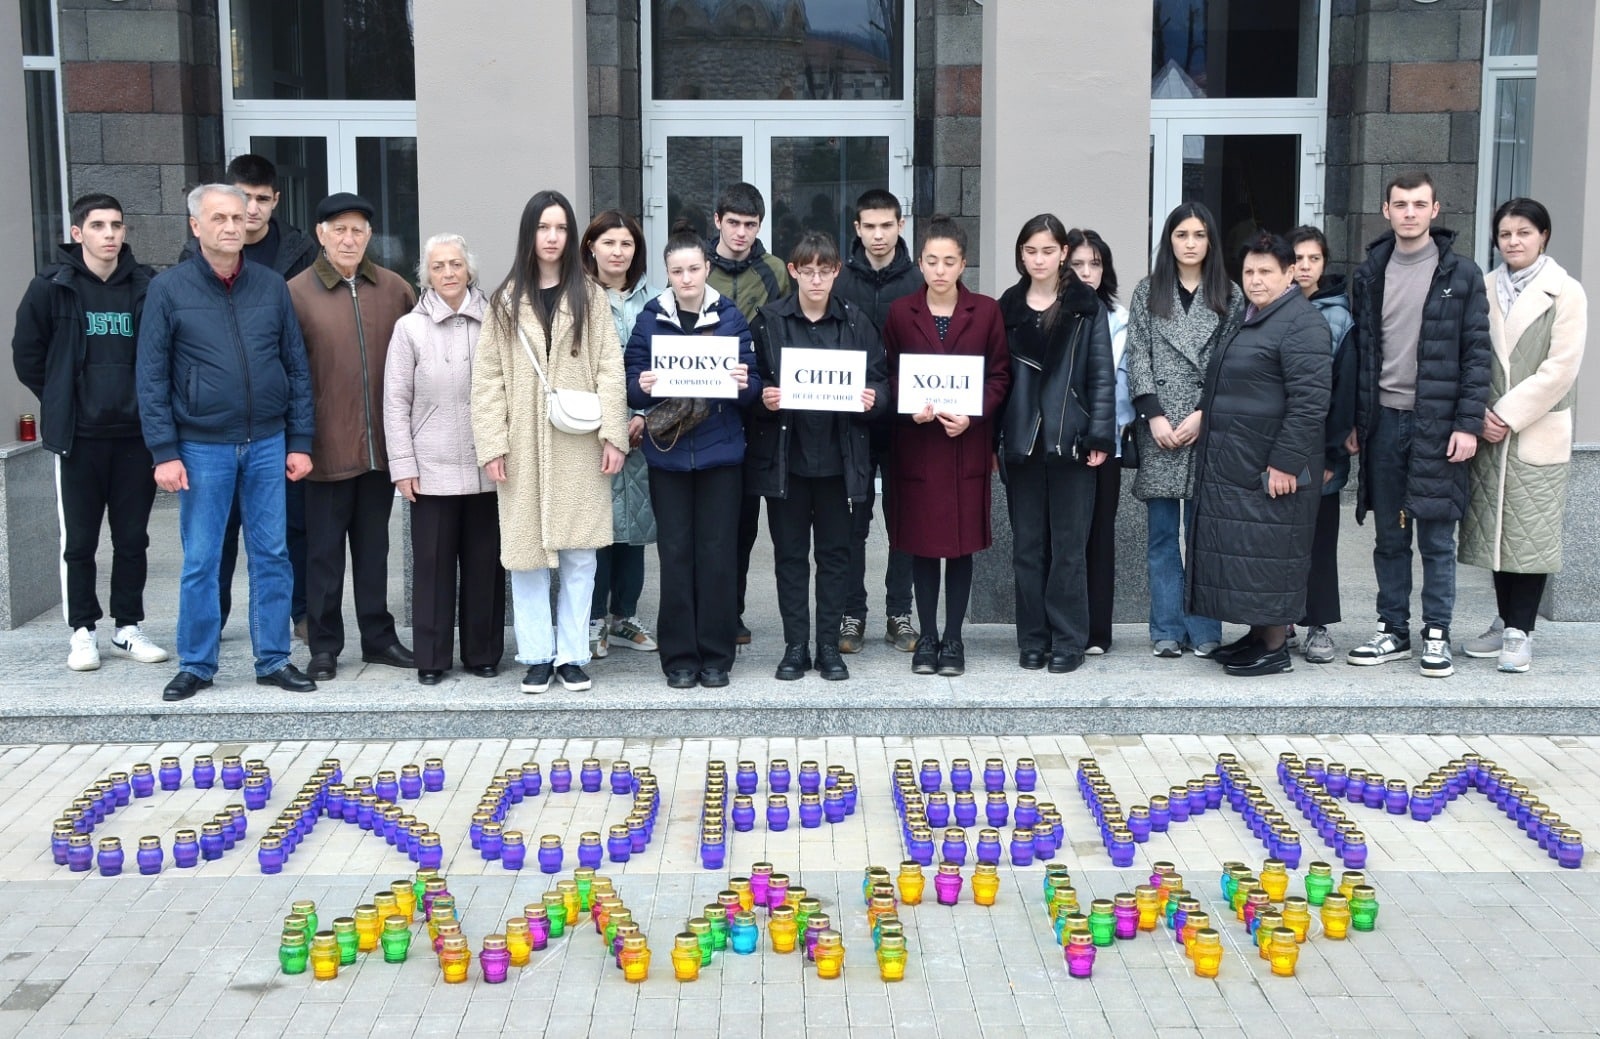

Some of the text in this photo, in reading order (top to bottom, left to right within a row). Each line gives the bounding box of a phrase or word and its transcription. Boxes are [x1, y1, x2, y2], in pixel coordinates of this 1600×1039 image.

[654, 355, 738, 370] КРОКУС
[794, 368, 852, 385] СИТИ
[912, 374, 970, 389] ХОЛЛ
